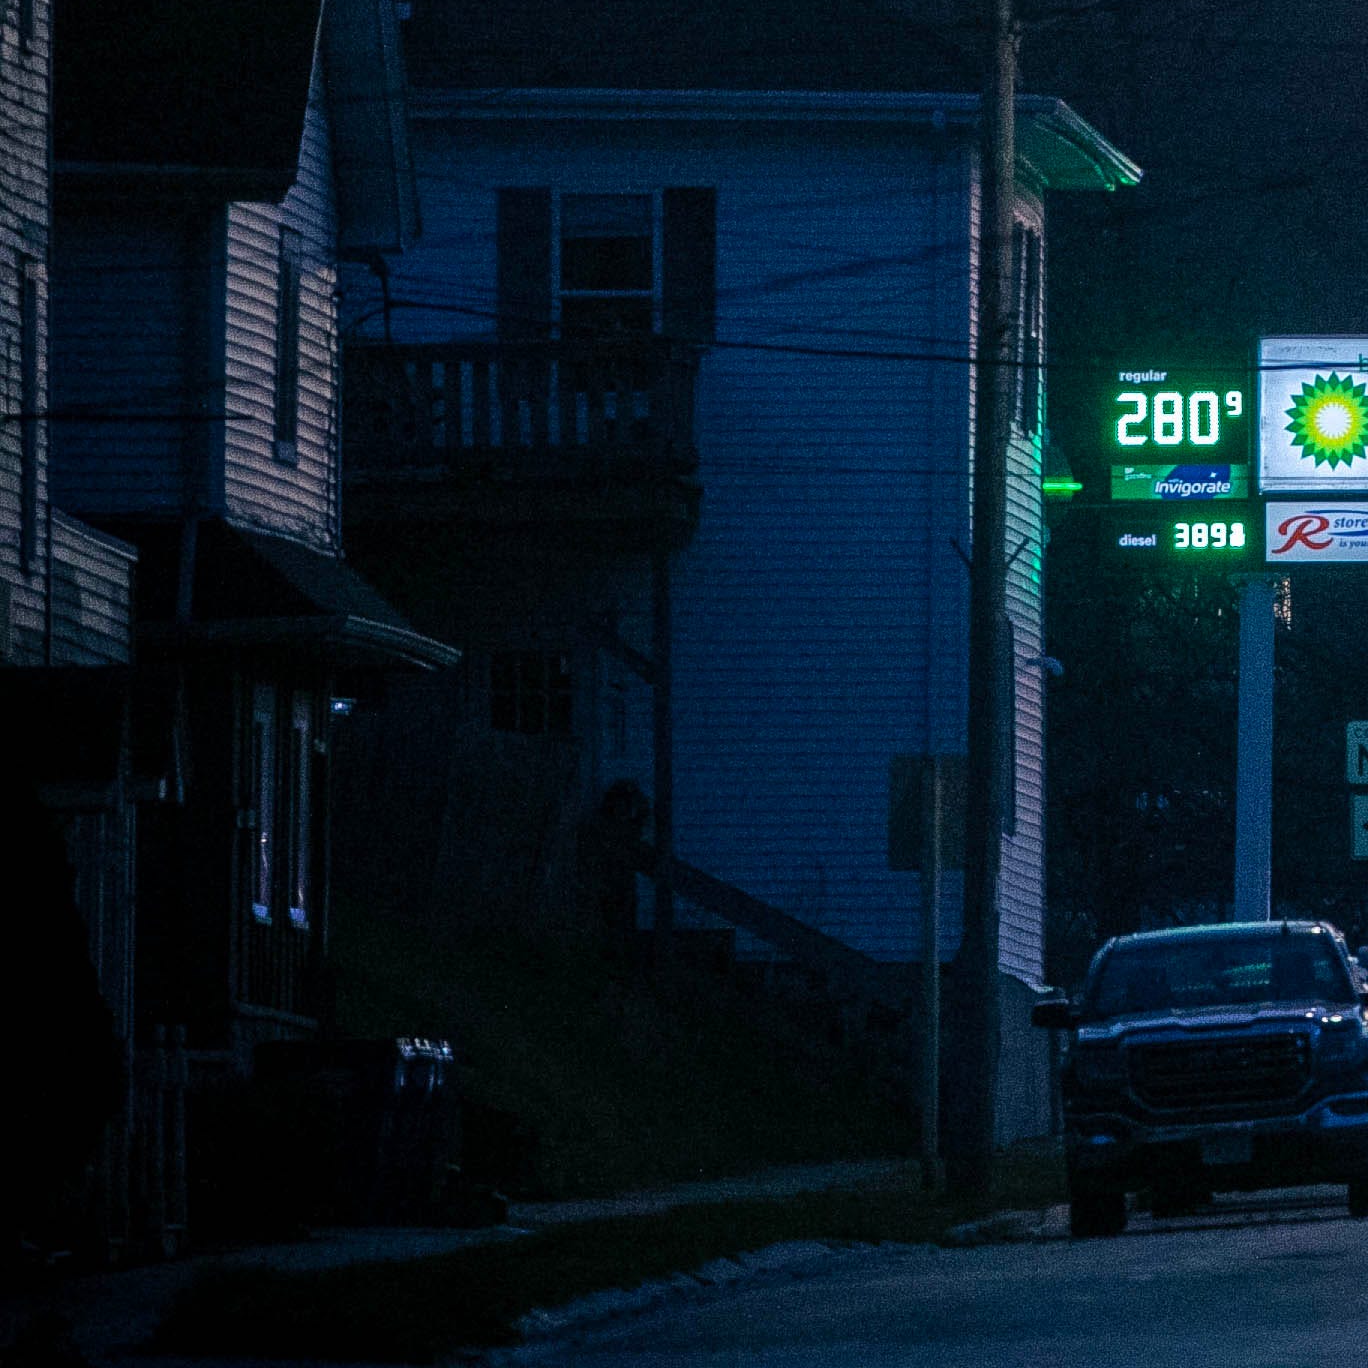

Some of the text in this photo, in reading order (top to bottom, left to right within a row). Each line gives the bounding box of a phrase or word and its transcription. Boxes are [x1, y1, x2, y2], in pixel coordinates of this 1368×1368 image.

[1119, 369, 1167, 384] regular
[1154, 480, 1231, 497] Invigorate
[1119, 534, 1157, 547] diesel
[1271, 515, 1368, 554] R store
[1339, 539, 1347, 548] is
